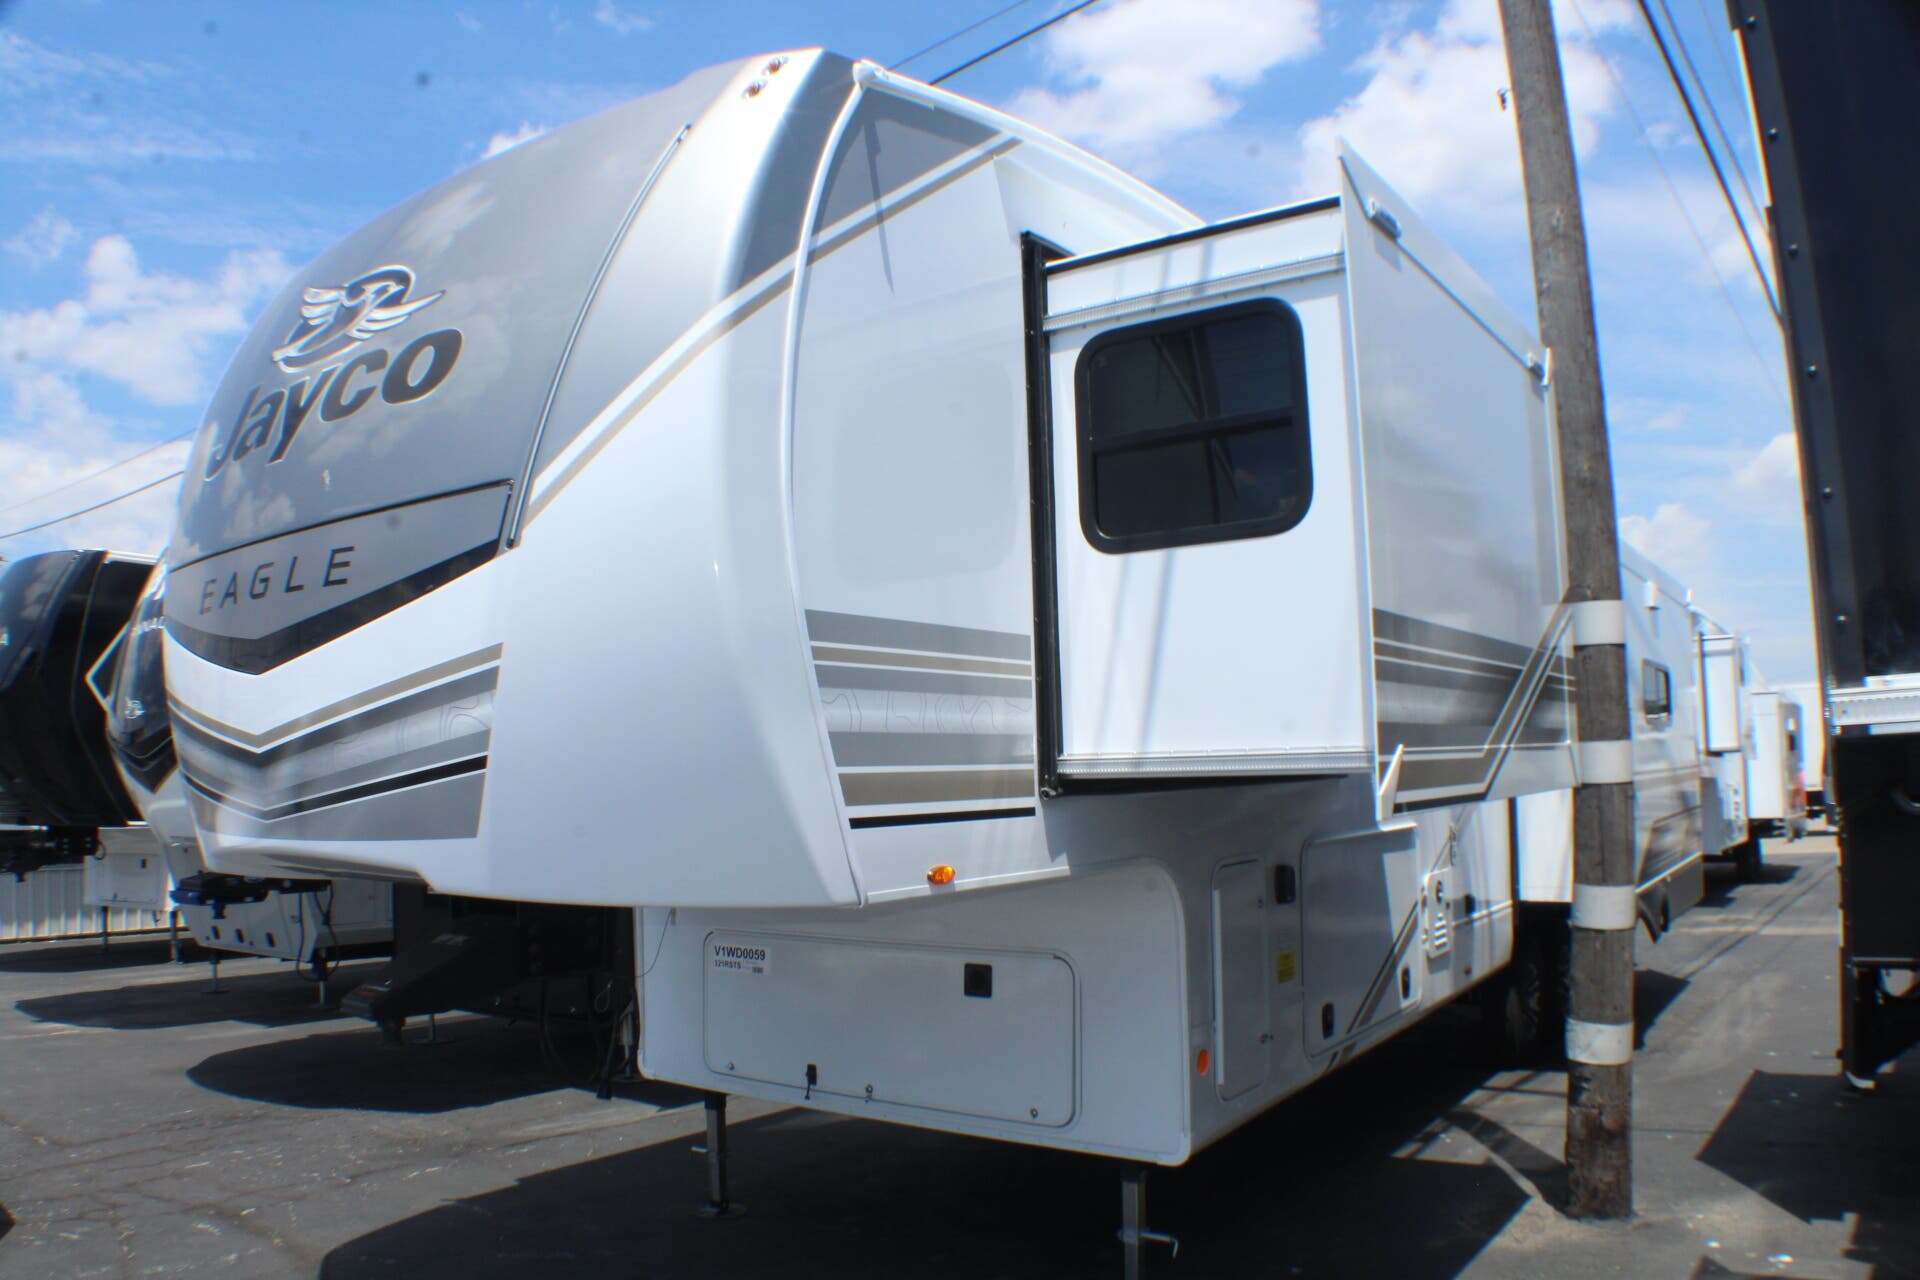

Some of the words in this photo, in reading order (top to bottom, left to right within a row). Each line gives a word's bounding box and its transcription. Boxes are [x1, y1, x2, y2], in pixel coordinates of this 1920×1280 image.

[204, 328, 463, 481] Jayco
[199, 546, 355, 615] EAGLE
[714, 945, 766, 960] V1WD0059
